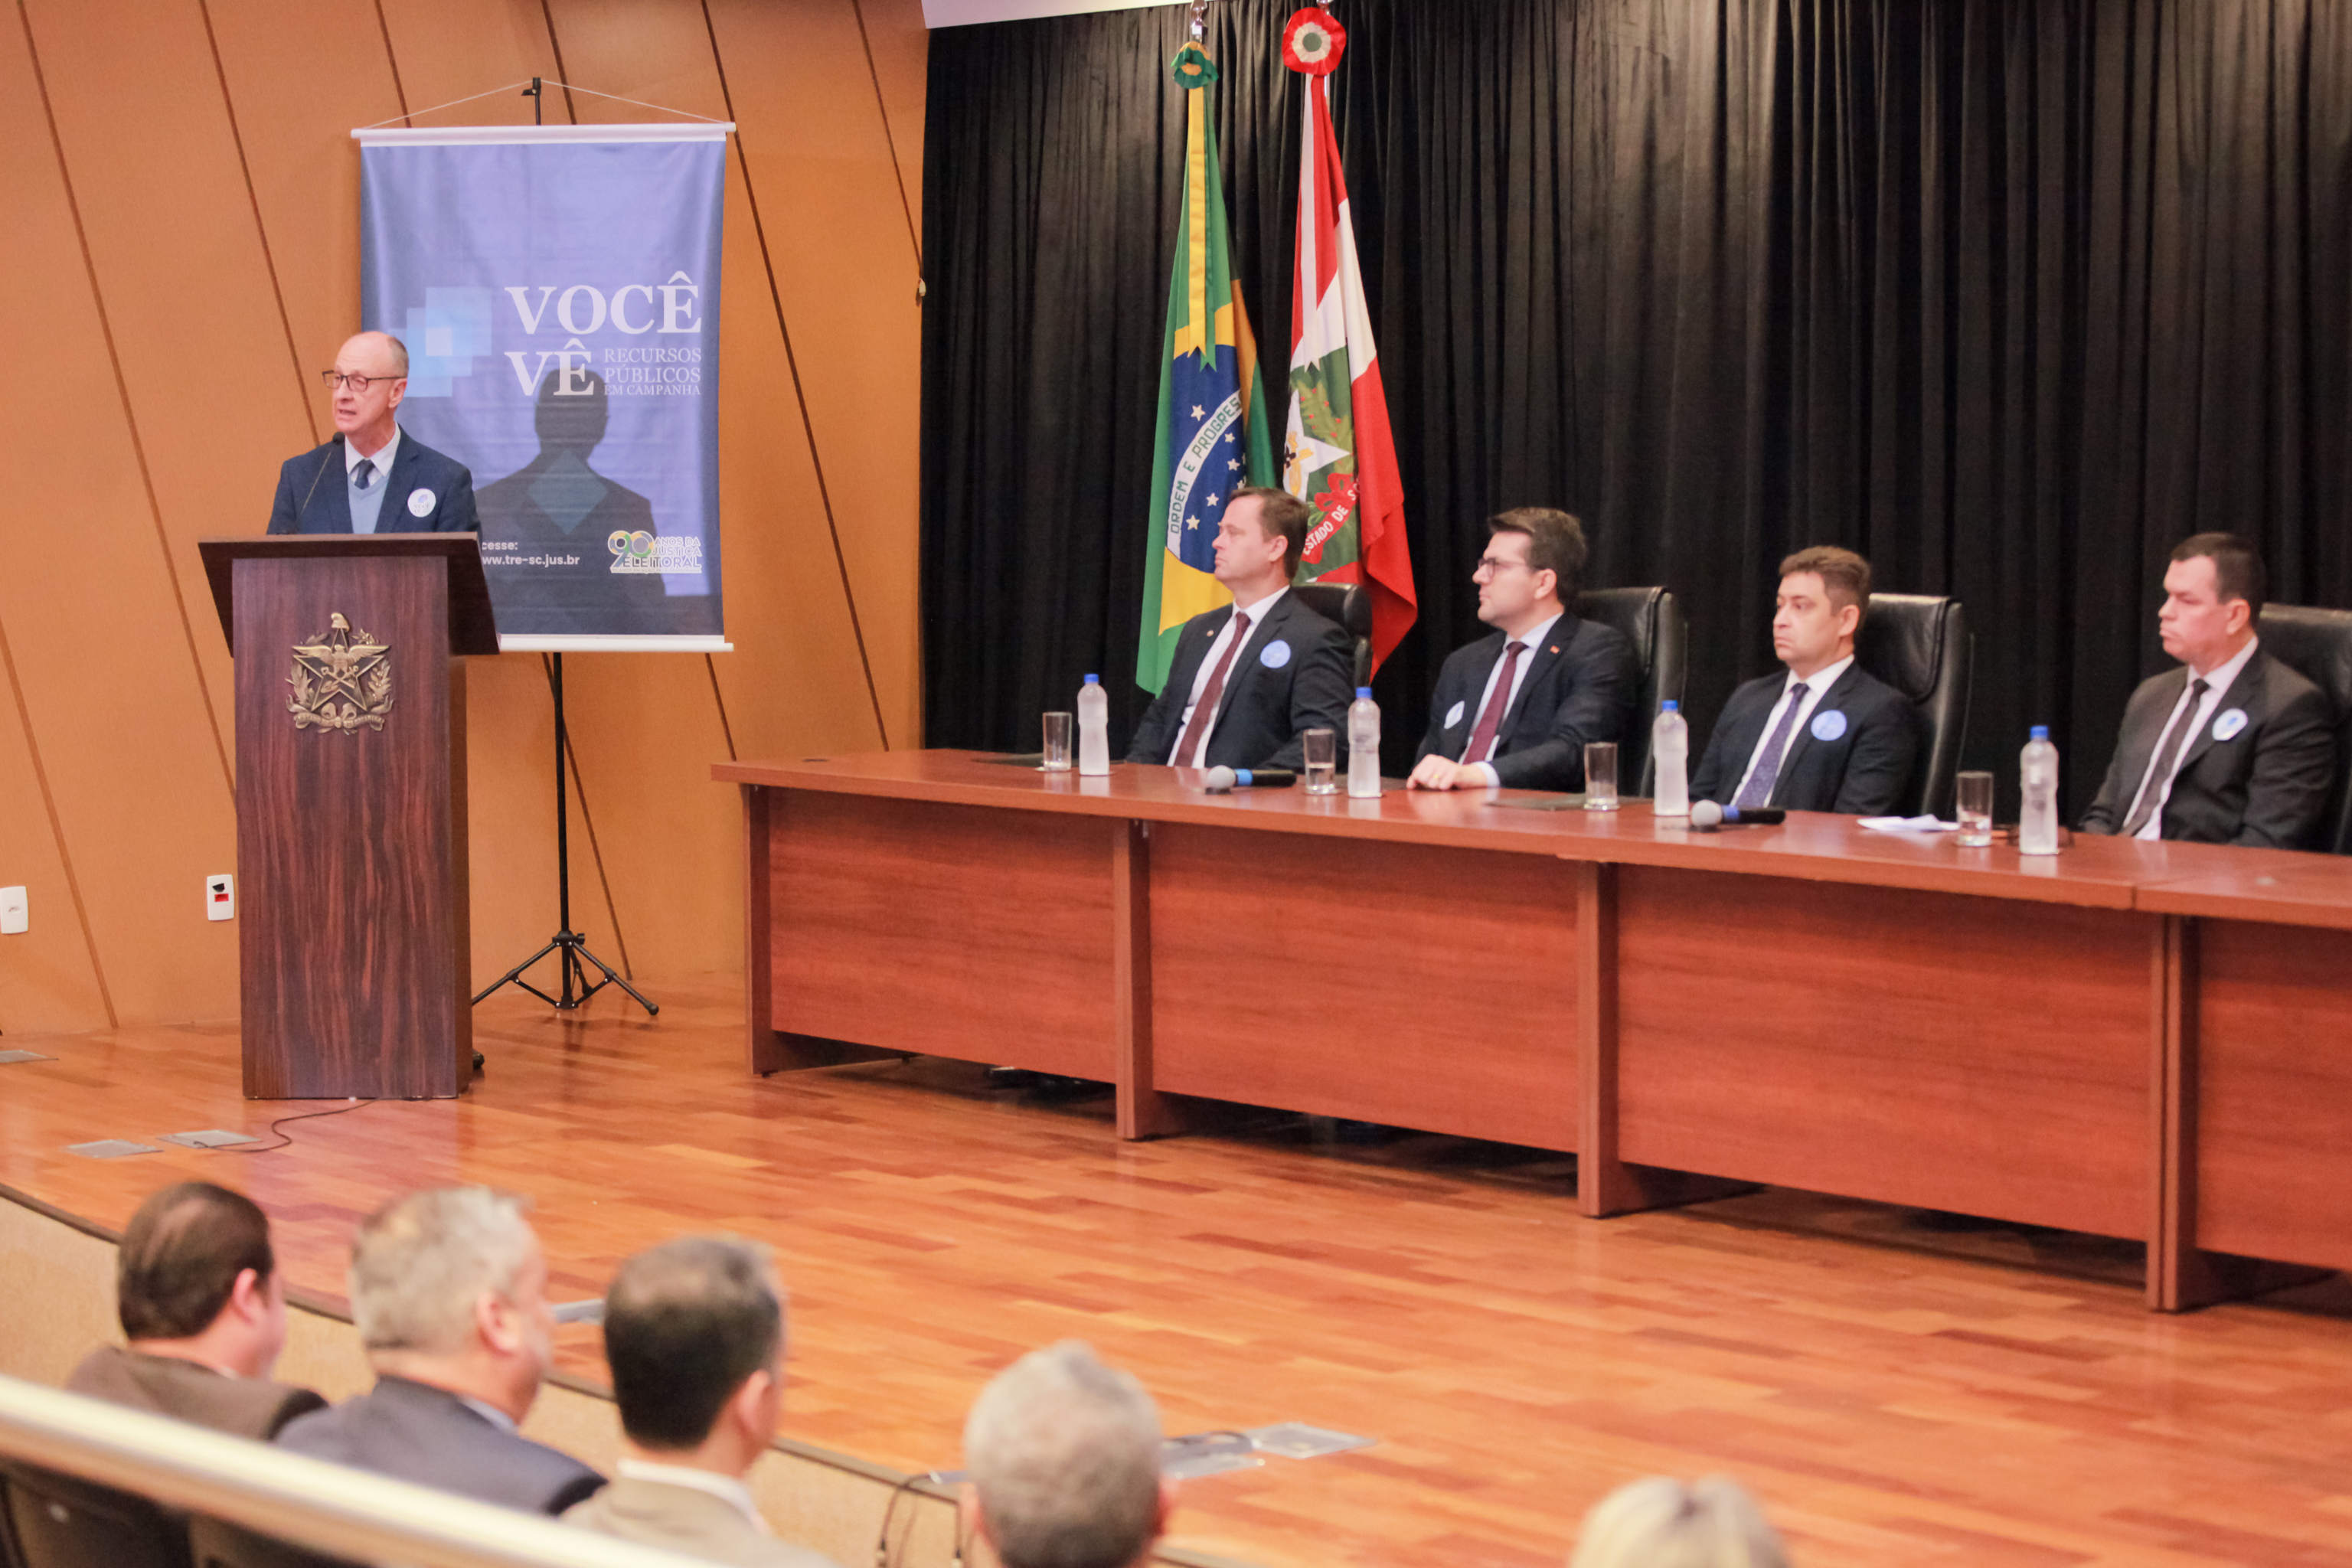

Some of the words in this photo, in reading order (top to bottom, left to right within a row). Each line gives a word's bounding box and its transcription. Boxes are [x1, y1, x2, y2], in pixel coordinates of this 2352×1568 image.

[504, 270, 702, 335] VOCÊ
[604, 348, 702, 363] RECURSOS
[504, 338, 595, 397] VÊ
[604, 364, 701, 384] PÚBLICOS
[604, 384, 626, 396] EM
[626, 384, 701, 396] CAMPANHA
[1170, 480, 1189, 534] ORDEM
[1183, 461, 1196, 472] E
[1191, 397, 1241, 459] PROGRES
[1302, 521, 1334, 556] ESTADO
[1331, 505, 1349, 522] DE
[482, 542, 518, 550] cesse:
[655, 536, 684, 547] ANOS
[684, 536, 701, 547] DA
[652, 546, 702, 557] JUSTIÇA
[482, 554, 580, 568] ww.tre-sc.jus.br
[622, 557, 702, 568] ELEITORAL
